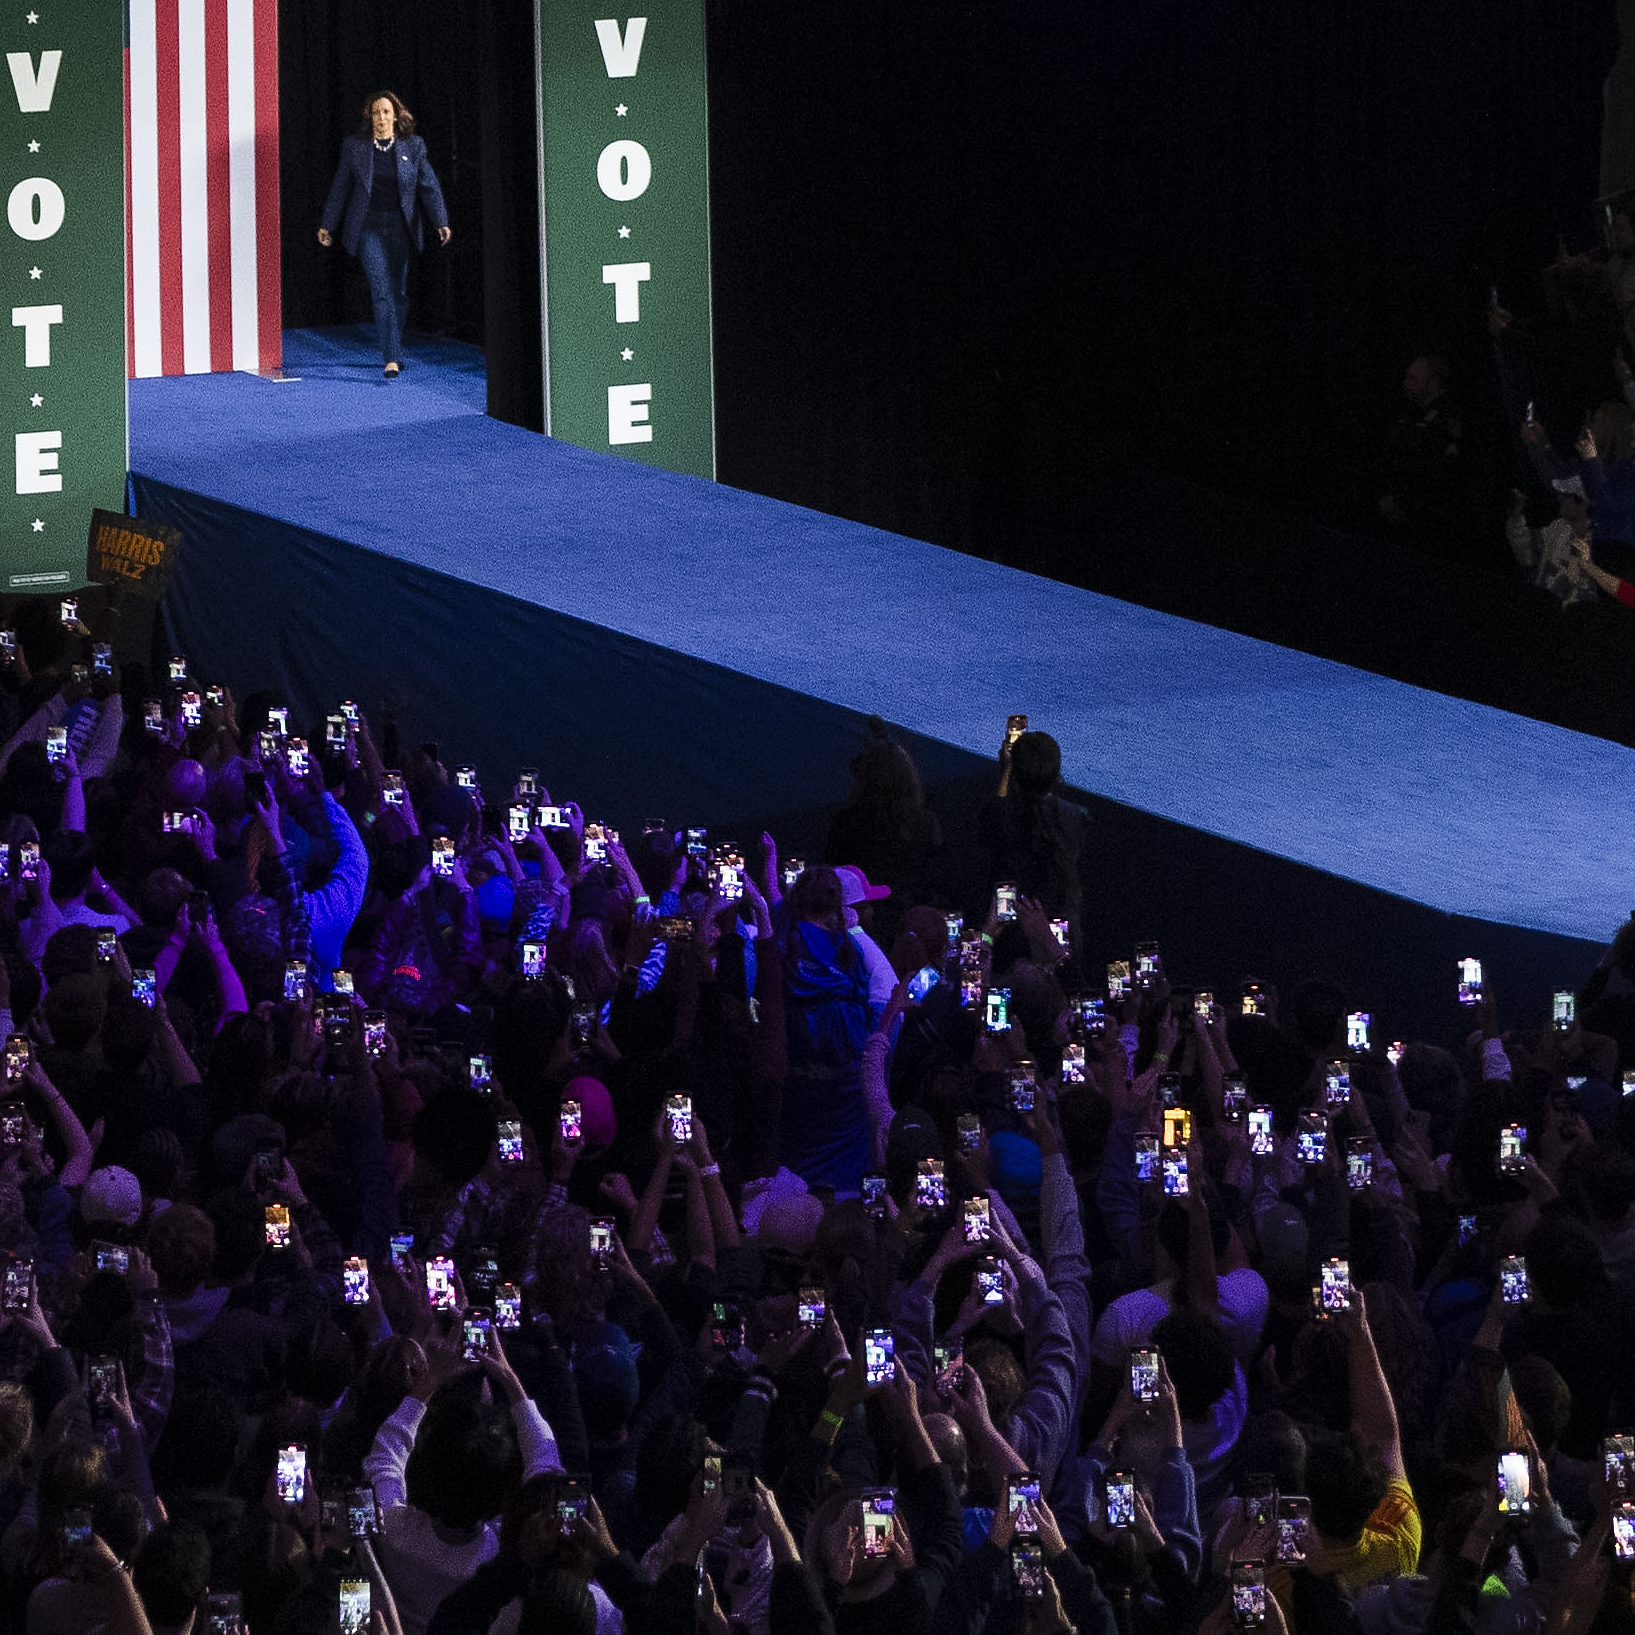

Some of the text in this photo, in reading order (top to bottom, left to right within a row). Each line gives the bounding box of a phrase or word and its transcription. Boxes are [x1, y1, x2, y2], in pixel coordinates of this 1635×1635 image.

[5, 49, 66, 495] VOTE
[594, 17, 654, 445] VOTE
[97, 525, 164, 567] HARRIS
